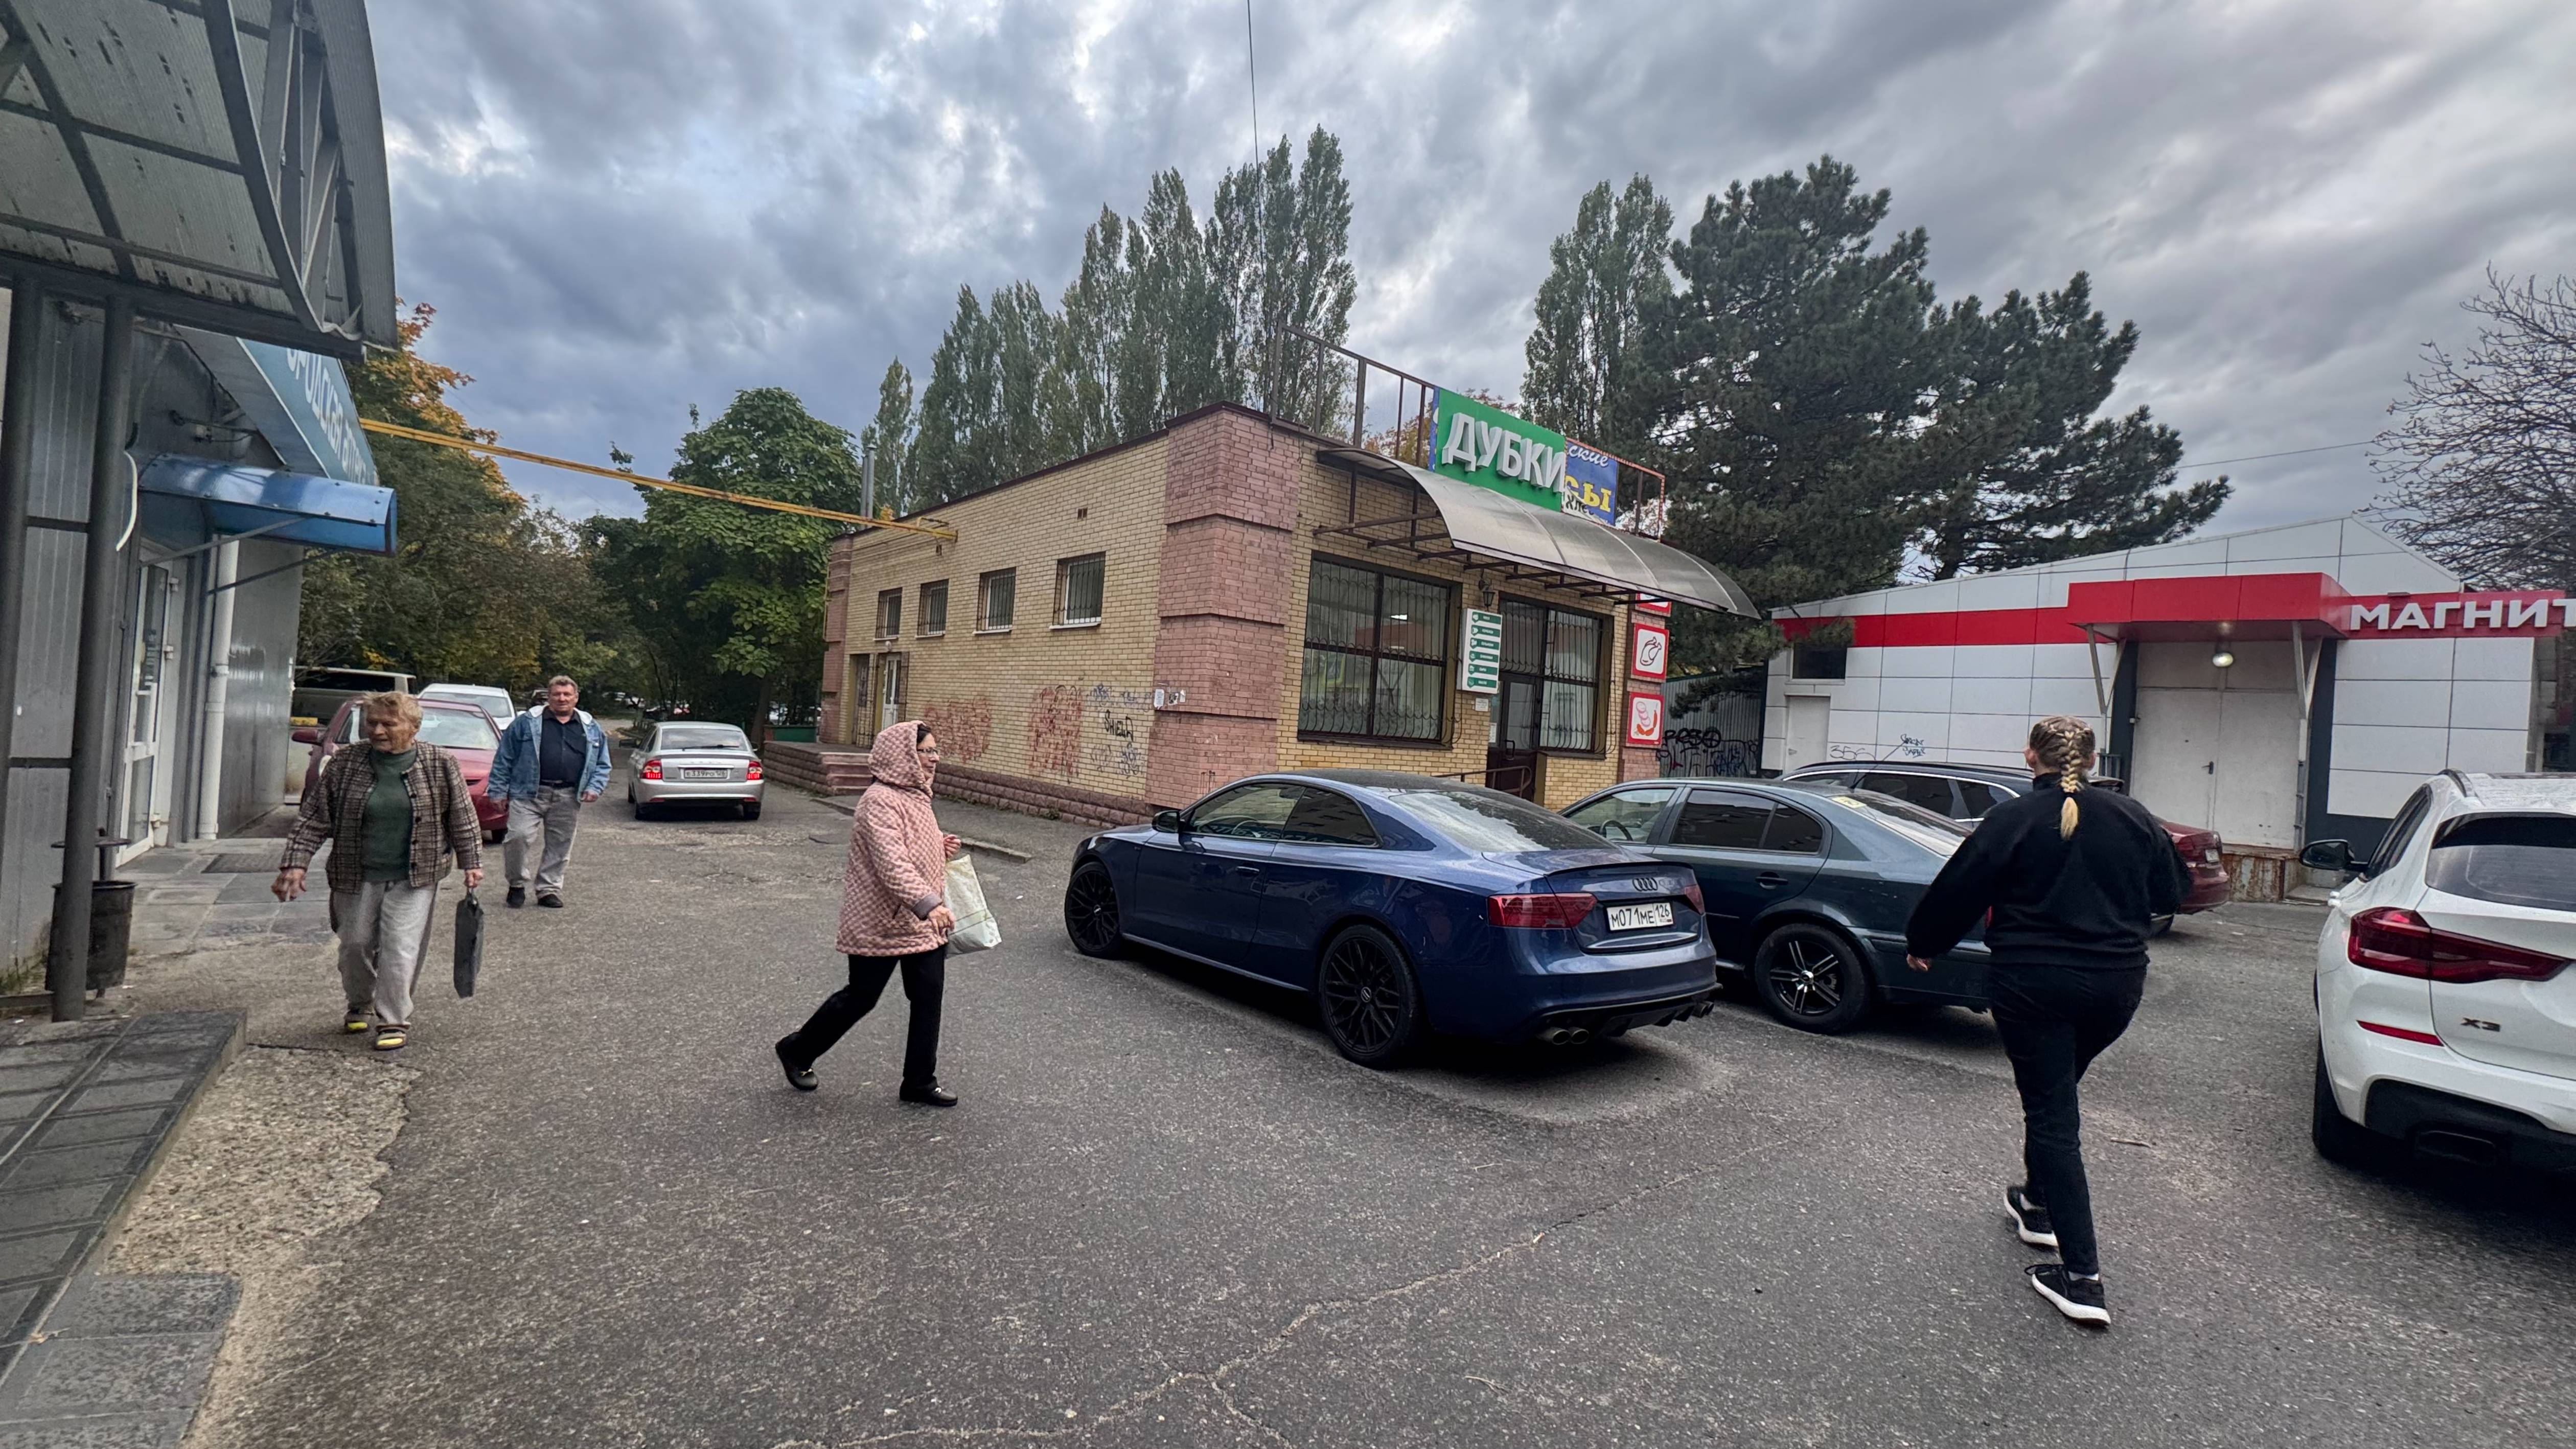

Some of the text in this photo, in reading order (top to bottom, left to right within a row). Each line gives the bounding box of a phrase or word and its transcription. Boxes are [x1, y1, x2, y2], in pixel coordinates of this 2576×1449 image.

[1442, 412, 1566, 493] ДУБКИ
[1568, 445, 1608, 467] ские
[2350, 599, 2576, 630] МАГНИТ
[1655, 904, 1670, 918] 126
[2460, 1017, 2500, 1032] X3
